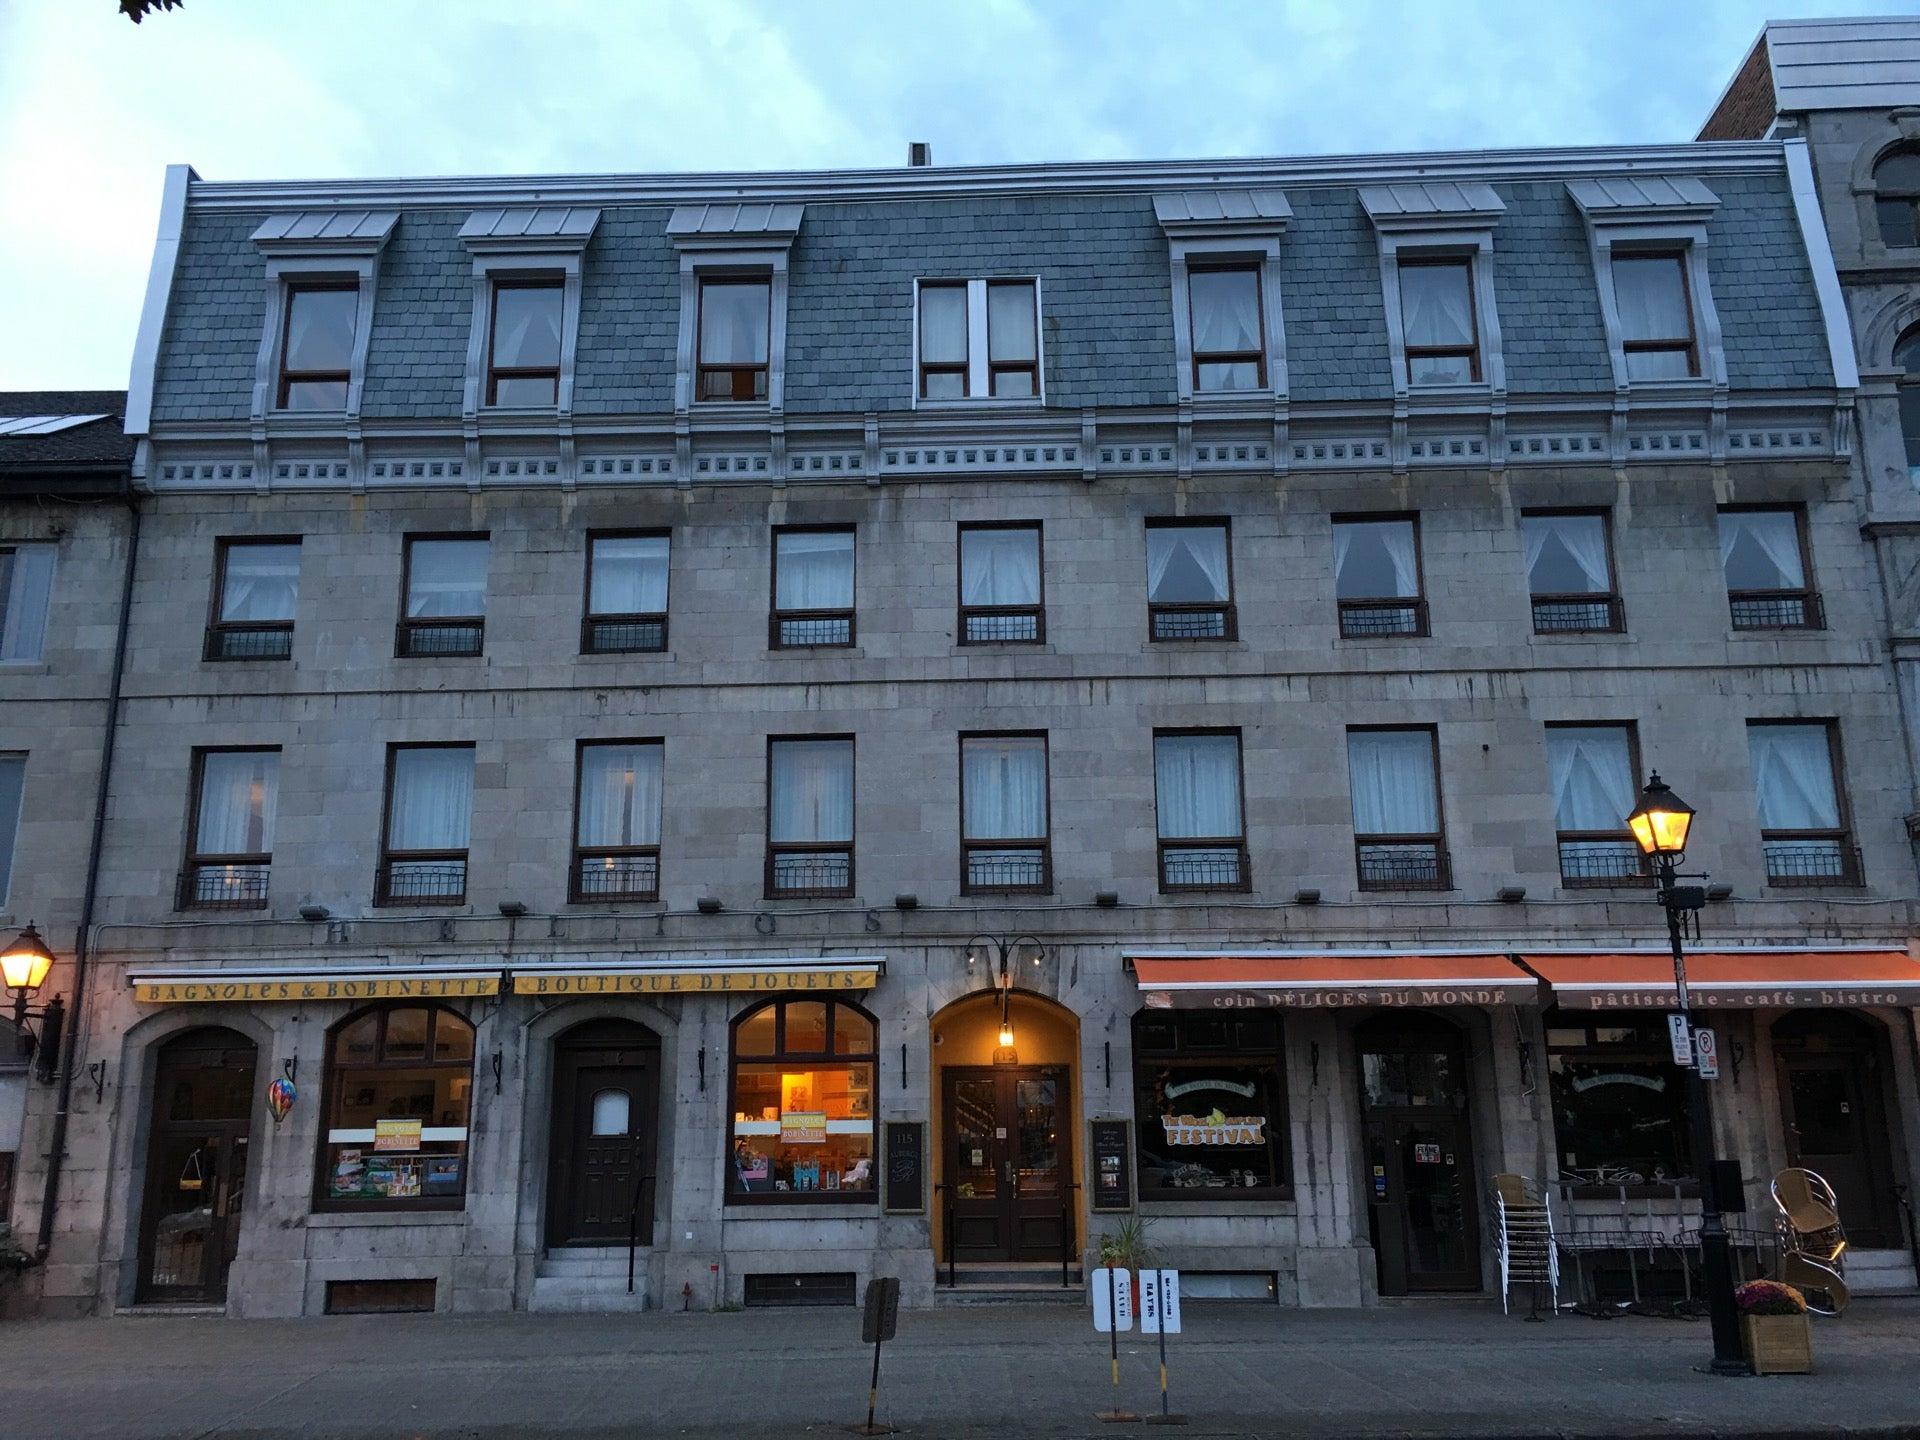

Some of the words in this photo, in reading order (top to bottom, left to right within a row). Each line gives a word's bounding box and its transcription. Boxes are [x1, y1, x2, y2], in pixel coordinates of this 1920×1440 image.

[301, 984, 315, 998] &
[537, 975, 681, 992] BOUTIQUE
[700, 974, 732, 989] DE
[749, 973, 854, 989] JOUETS
[1213, 994, 1256, 1007] coin
[1267, 990, 1368, 1006] DÉLICES
[1380, 992, 1409, 1005] DU
[1421, 990, 1507, 1005] MONDE
[1590, 992, 1718, 1009] pâtisseie
[1744, 991, 1796, 1006] café
[1820, 990, 1898, 1005] bistro
[895, 1133, 913, 1144] 115
